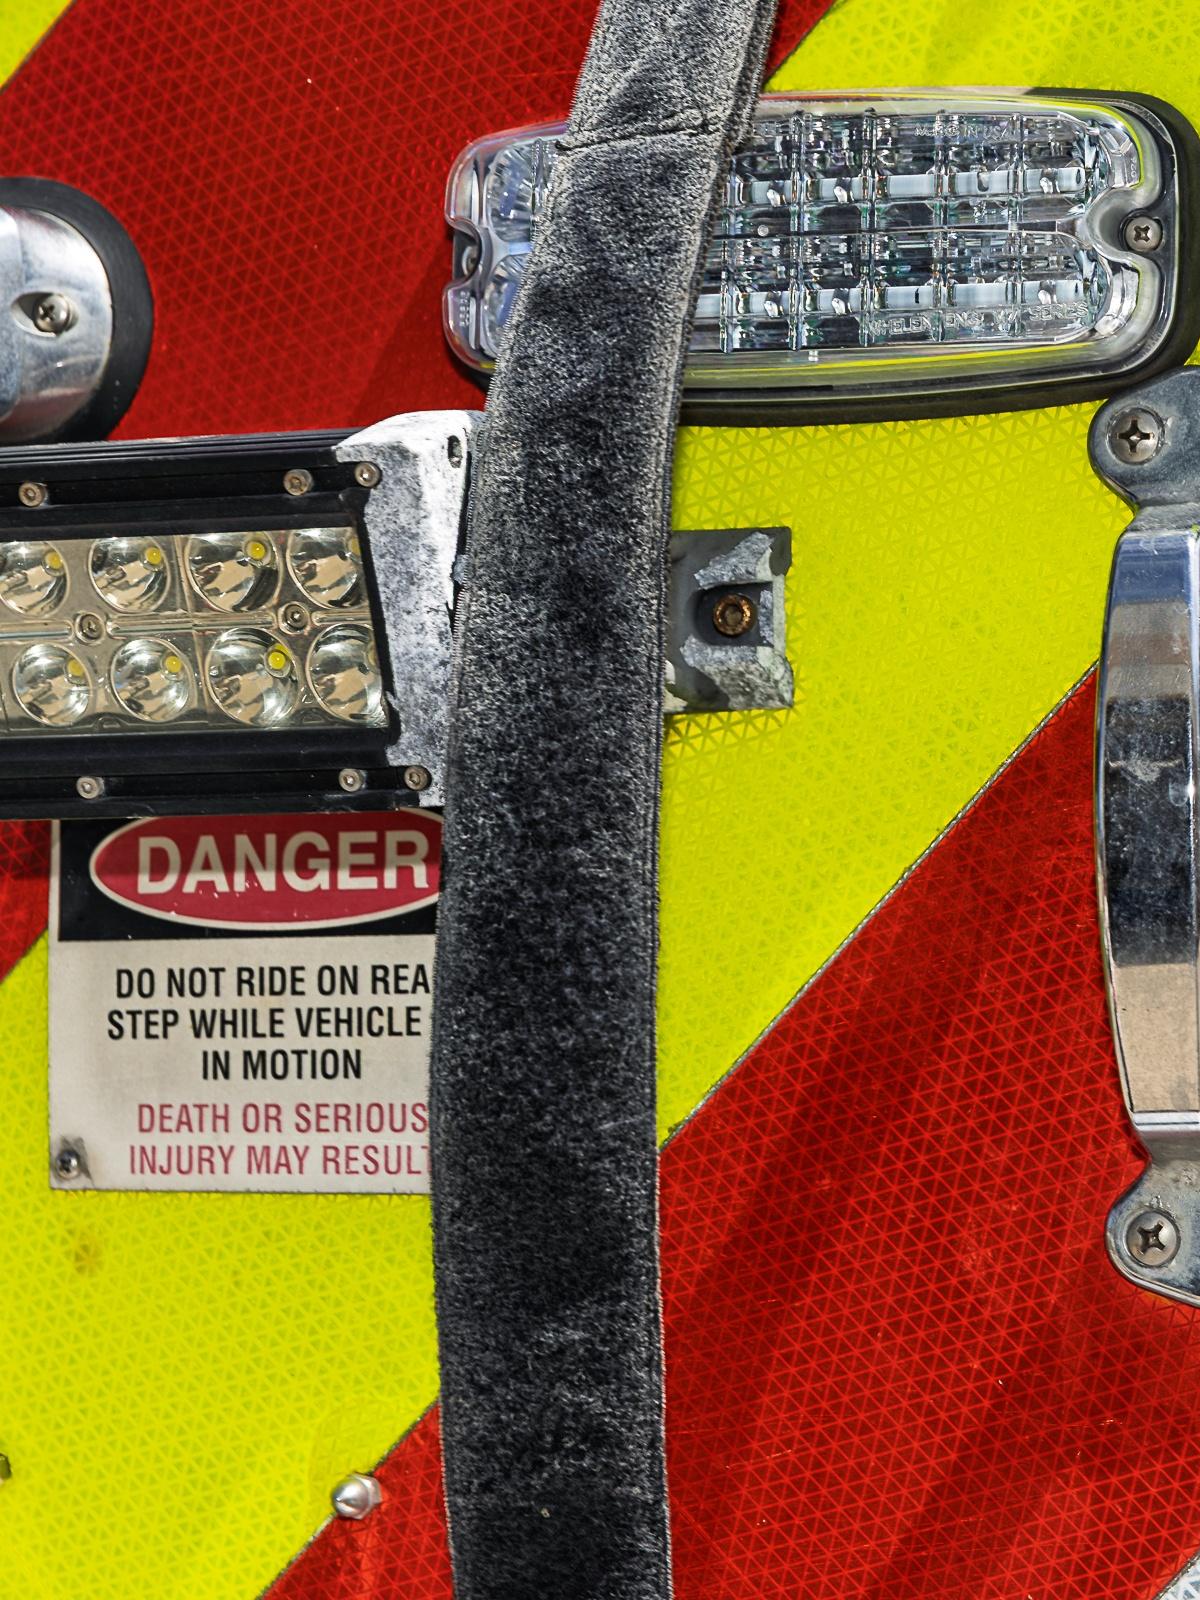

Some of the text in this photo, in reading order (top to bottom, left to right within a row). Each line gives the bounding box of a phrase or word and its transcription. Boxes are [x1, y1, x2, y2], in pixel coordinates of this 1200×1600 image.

[137, 829, 430, 894] DANGER
[116, 963, 431, 999] DO NOT RIDE ON REA
[107, 1005, 422, 1040] STEP WHILE VEHICLE
[202, 1048, 362, 1081] IN MOTION
[137, 1102, 430, 1134] DEATH OR SERIOUS
[129, 1145, 235, 1175] INJURY
[247, 1145, 310, 1175] MAY
